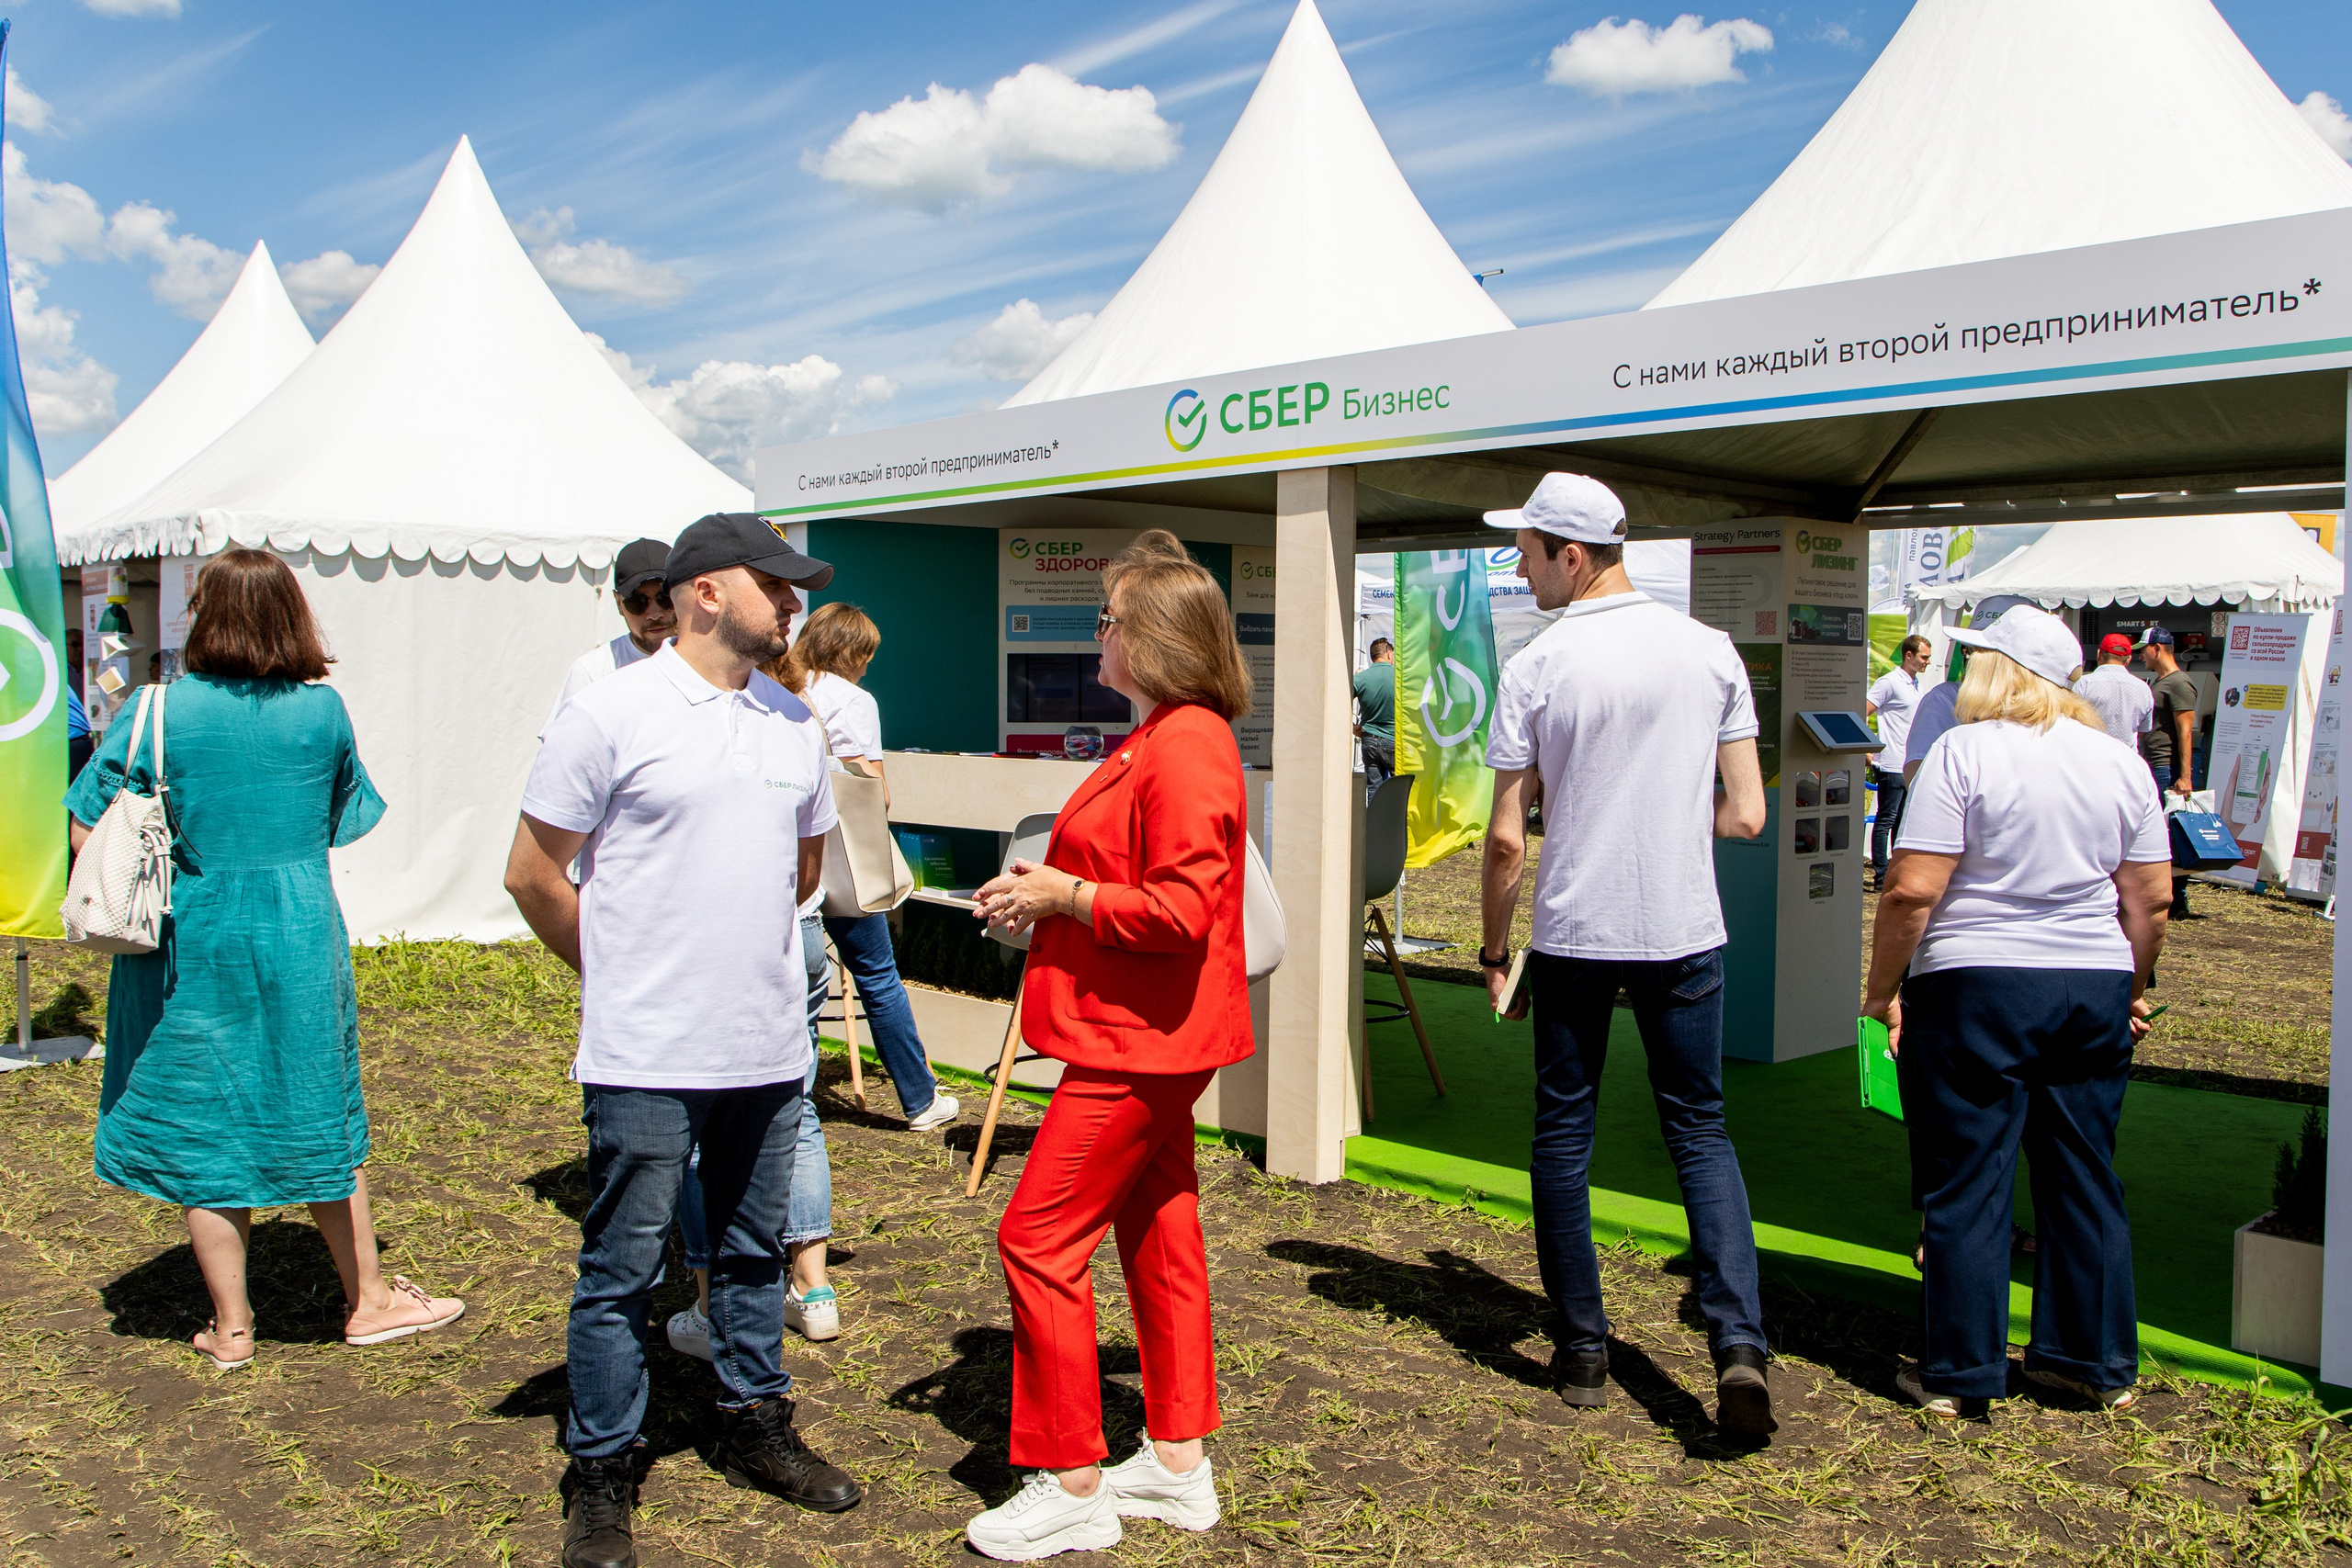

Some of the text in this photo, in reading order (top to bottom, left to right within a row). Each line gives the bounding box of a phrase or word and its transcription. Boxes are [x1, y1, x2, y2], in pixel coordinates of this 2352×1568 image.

[1612, 364, 1631, 389] С
[1640, 361, 1706, 386] нами
[1715, 337, 1827, 376] каждый
[1839, 322, 1949, 363] второй
[1219, 381, 1450, 434] СБЕР Бизнес
[798, 475, 807, 491] С
[808, 475, 836, 490] нами
[839, 464, 883, 486] каждый
[886, 457, 928, 480] второй
[1694, 529, 1781, 544] Strategy Partners
[1812, 536, 1843, 552] СБЕР
[1035, 542, 1083, 556] СБЕР
[1035, 558, 1114, 573] ЗДОРОВ
[1812, 554, 1859, 571] ЛИЗИНГ
[1797, 577, 1826, 585] Лизинговое
[1372, 585, 1532, 598] СЕМЕН ДСТВА ЗАЩ
[1813, 589, 1832, 598] бизнеса
[1985, 611, 2004, 619] СБ
